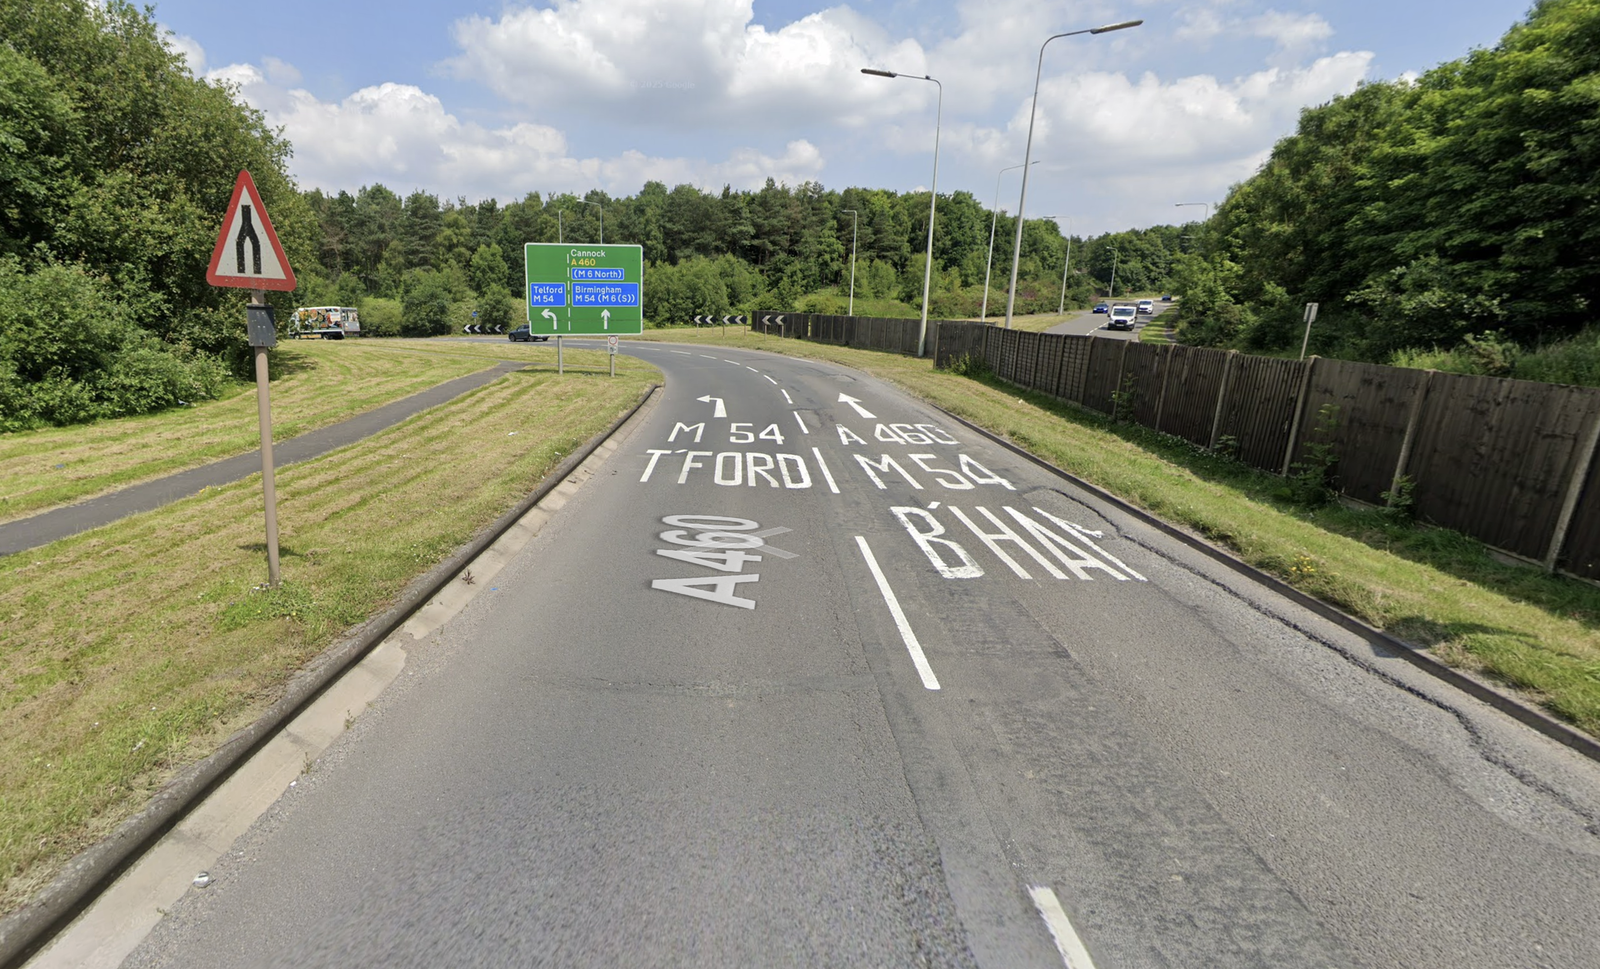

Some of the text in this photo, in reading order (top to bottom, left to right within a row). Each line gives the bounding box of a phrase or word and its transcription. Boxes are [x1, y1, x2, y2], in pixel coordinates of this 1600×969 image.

[571, 249, 606, 257] Cannock
[571, 258, 596, 266] A 460
[595, 269, 622, 279] North)
[533, 286, 563, 294] Telford
[575, 286, 622, 295] Birmingham
[639, 449, 813, 489] T'FORD
